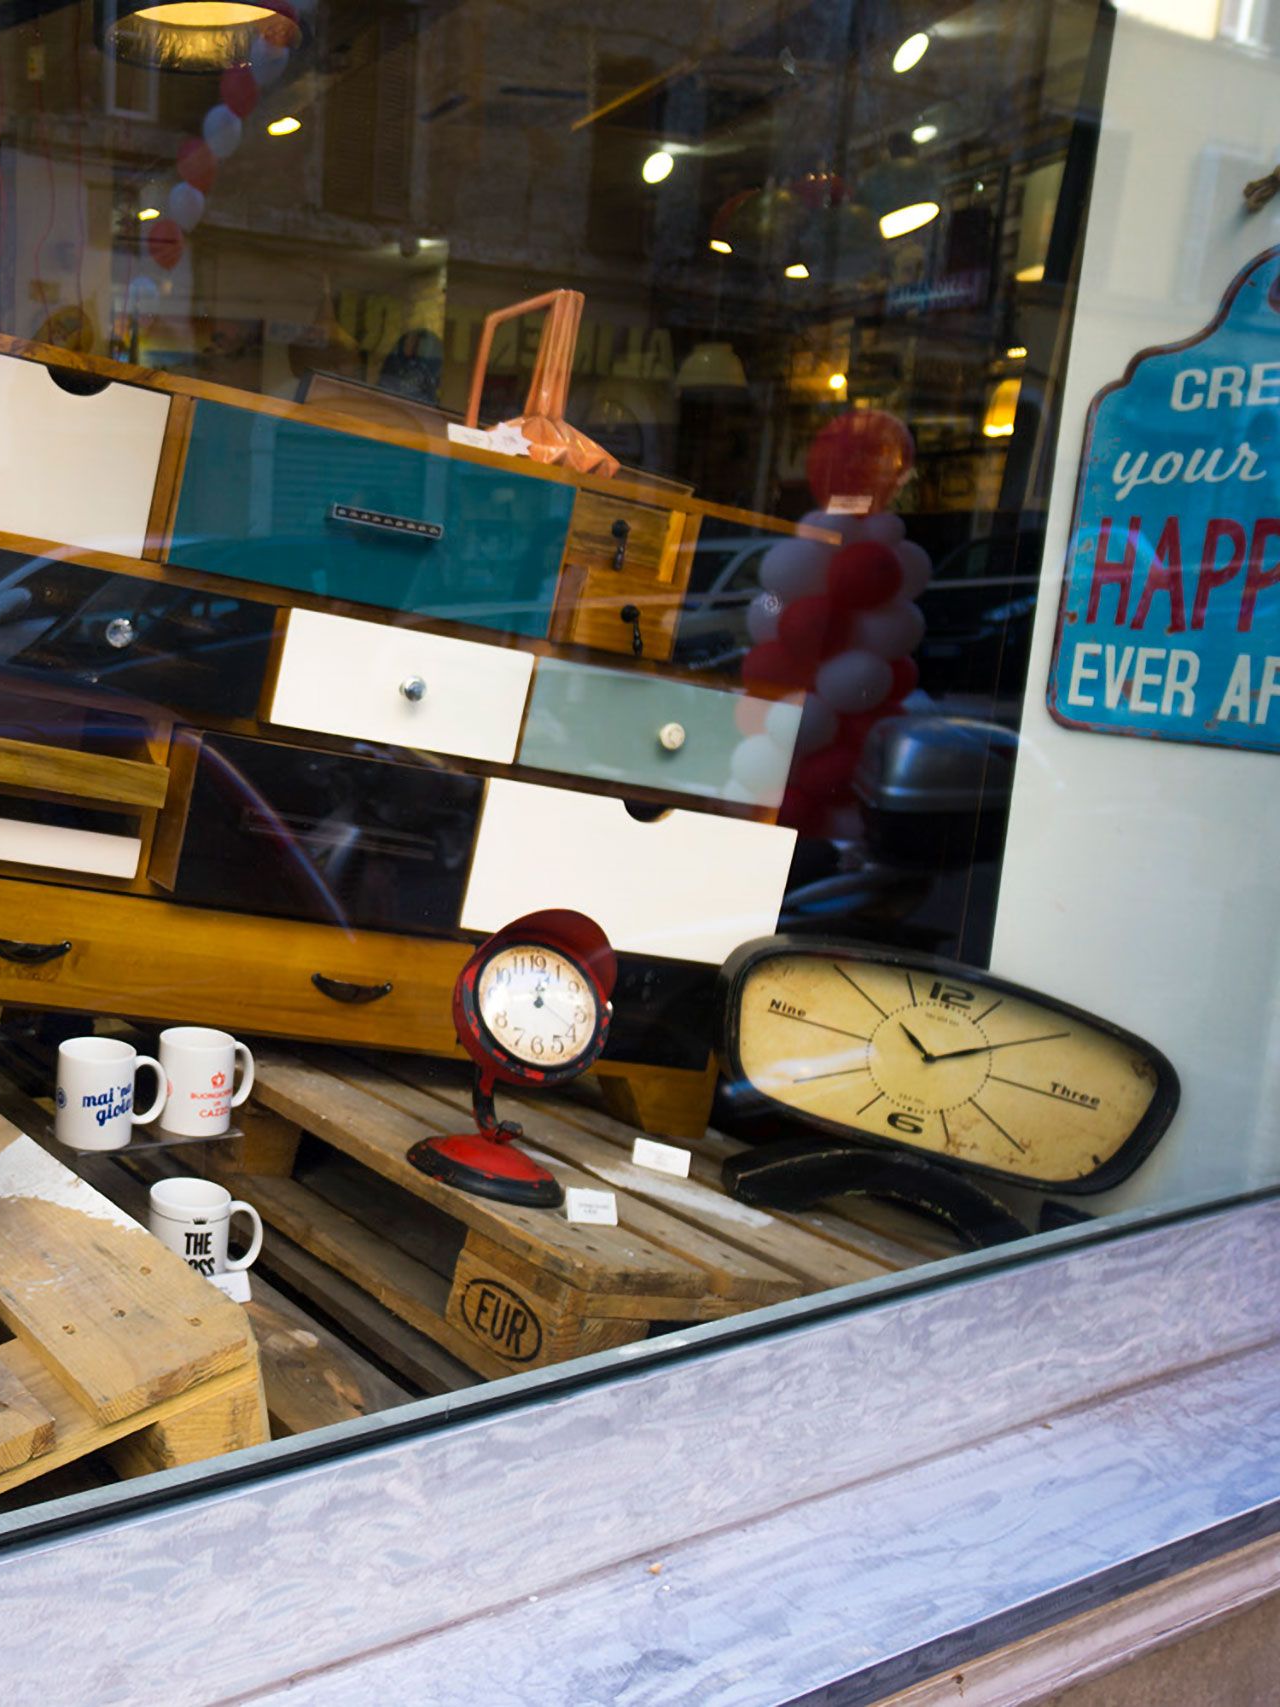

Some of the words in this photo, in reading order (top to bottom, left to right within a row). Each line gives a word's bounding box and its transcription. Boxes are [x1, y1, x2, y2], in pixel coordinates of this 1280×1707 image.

[1171, 366, 1280, 412] CRE
[1113, 443, 1267, 501] your
[1068, 643, 1201, 717] EVER
[513, 955, 525, 975] 11
[529, 954, 547, 973] 12
[930, 982, 974, 1010] 12
[769, 999, 807, 1018] Nine
[513, 1027, 525, 1046] 7
[565, 1023, 577, 1042] 4
[531, 1036, 544, 1055] 6
[551, 1035, 564, 1055] 5
[82, 1088, 114, 1107] mai
[1050, 1082, 1102, 1107] Three
[887, 1112, 924, 1135] 6
[184, 1232, 212, 1255] THE
[475, 1287, 528, 1354] EUR
